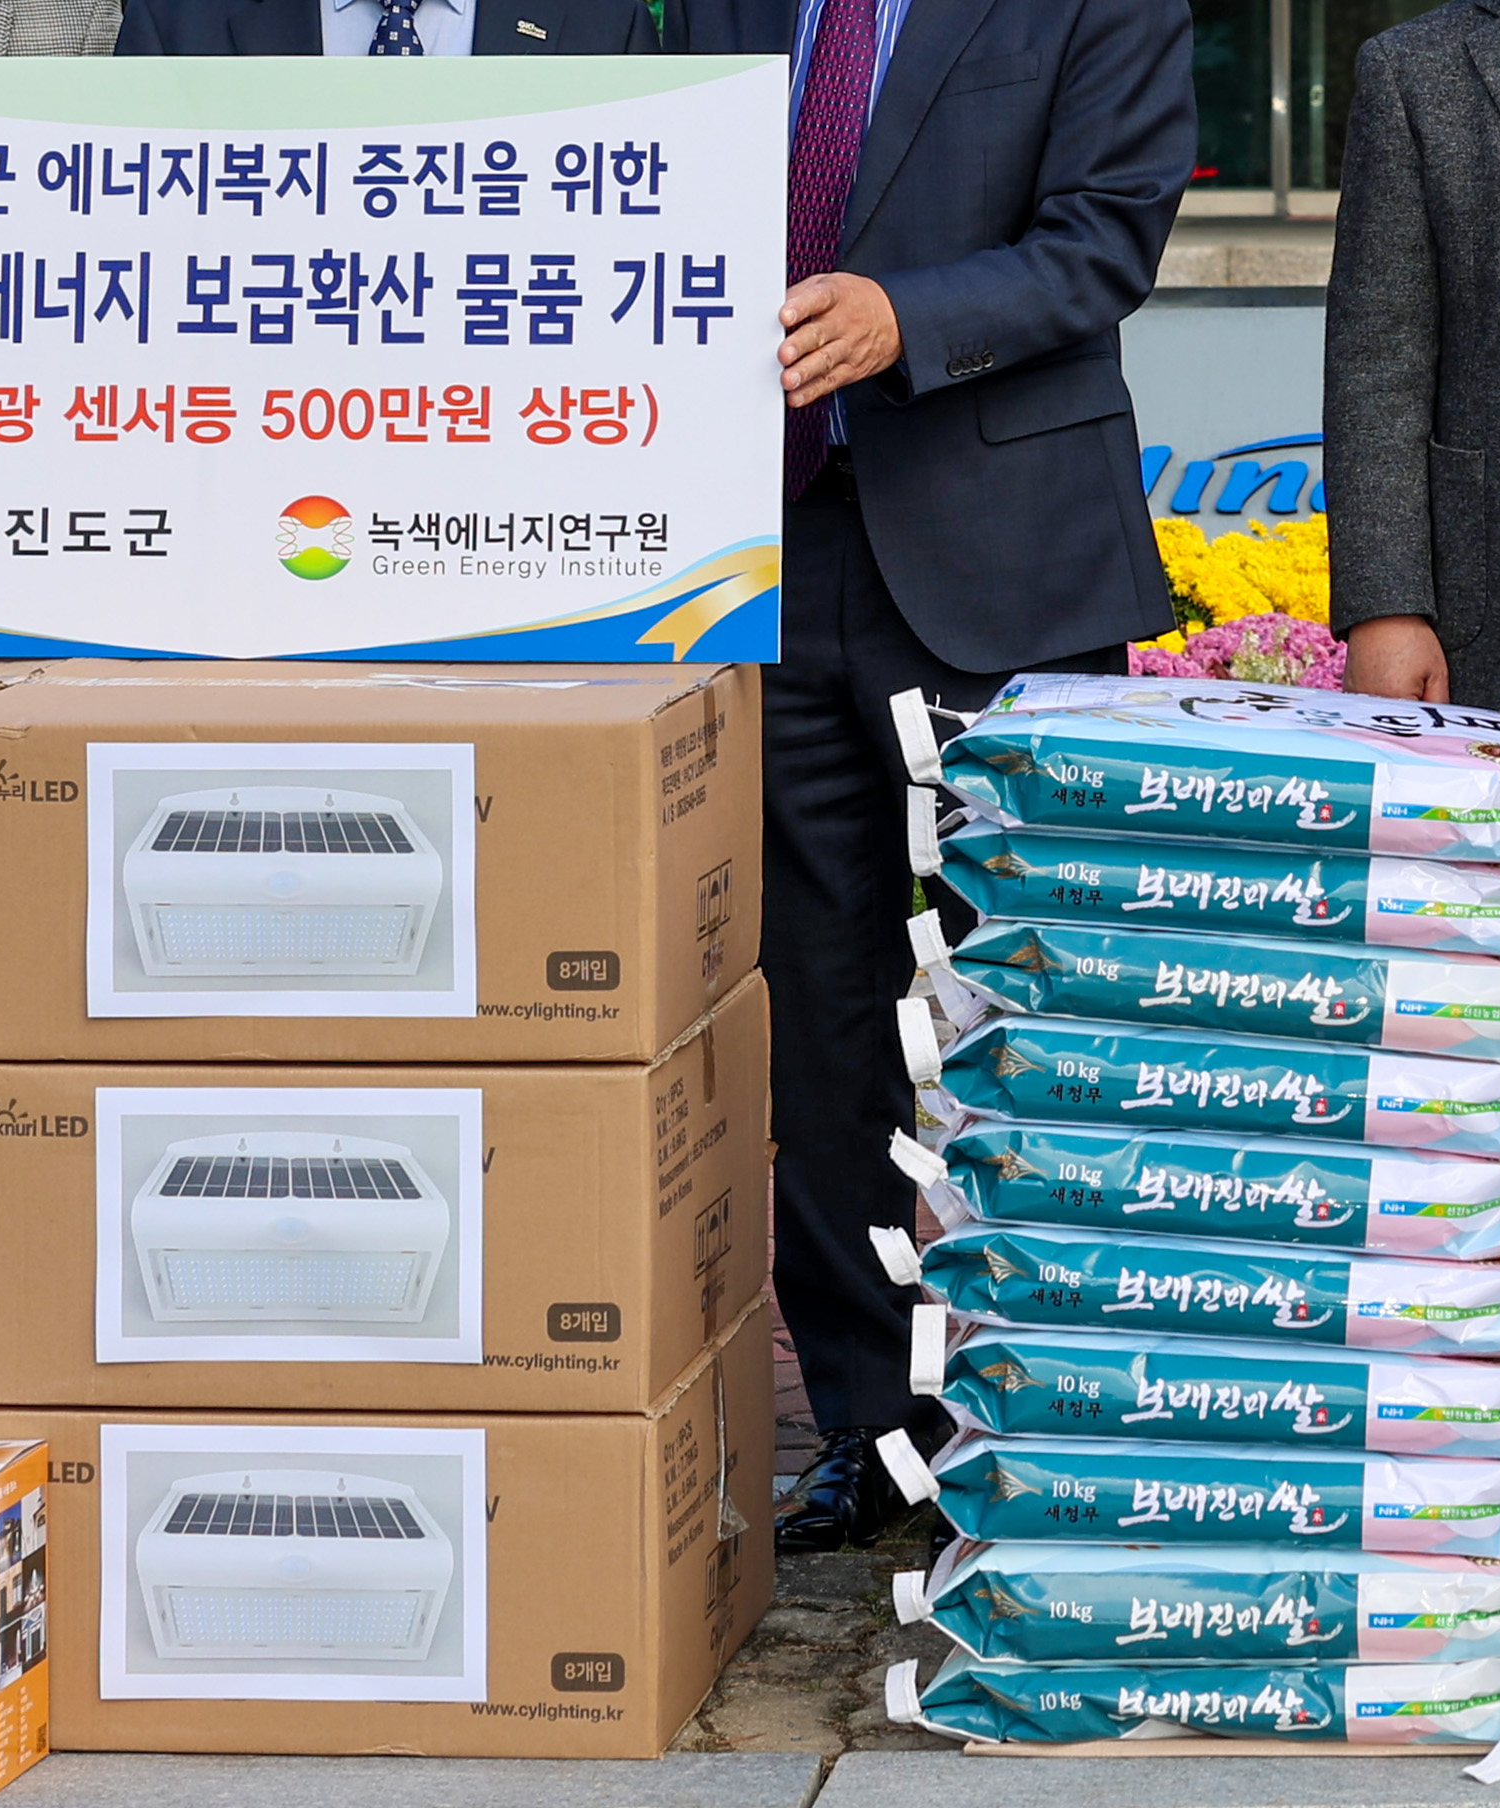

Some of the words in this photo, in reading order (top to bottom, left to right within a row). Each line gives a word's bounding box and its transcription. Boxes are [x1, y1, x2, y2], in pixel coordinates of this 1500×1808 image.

[38, 142, 327, 216] 에너지복지
[353, 141, 528, 218] 증진을
[551, 141, 668, 215] 위한
[177, 249, 433, 345] 보급확산
[457, 254, 582, 345] 물품
[611, 252, 733, 345] 기부
[64, 385, 237, 444] 센서등
[262, 385, 490, 442] 500만원
[519, 384, 658, 446] 상당)
[5, 507, 172, 556] 진도군
[368, 513, 667, 557] 녹색에너지연구원
[373, 555, 445, 575] Green
[461, 556, 546, 579] Energy
[562, 557, 662, 576] Institute
[31, 781, 79, 803] LED
[560, 958, 608, 982] 8개입
[476, 1003, 619, 1021] ww.cylighting.kr
[41, 1115, 89, 1139] LED
[560, 1310, 608, 1334] 8개입
[473, 1350, 620, 1372] ww.cylighting.kr
[47, 1462, 95, 1485] LED
[564, 1661, 613, 1684] 8개입
[470, 1702, 624, 1723] www.cylighting.kr
